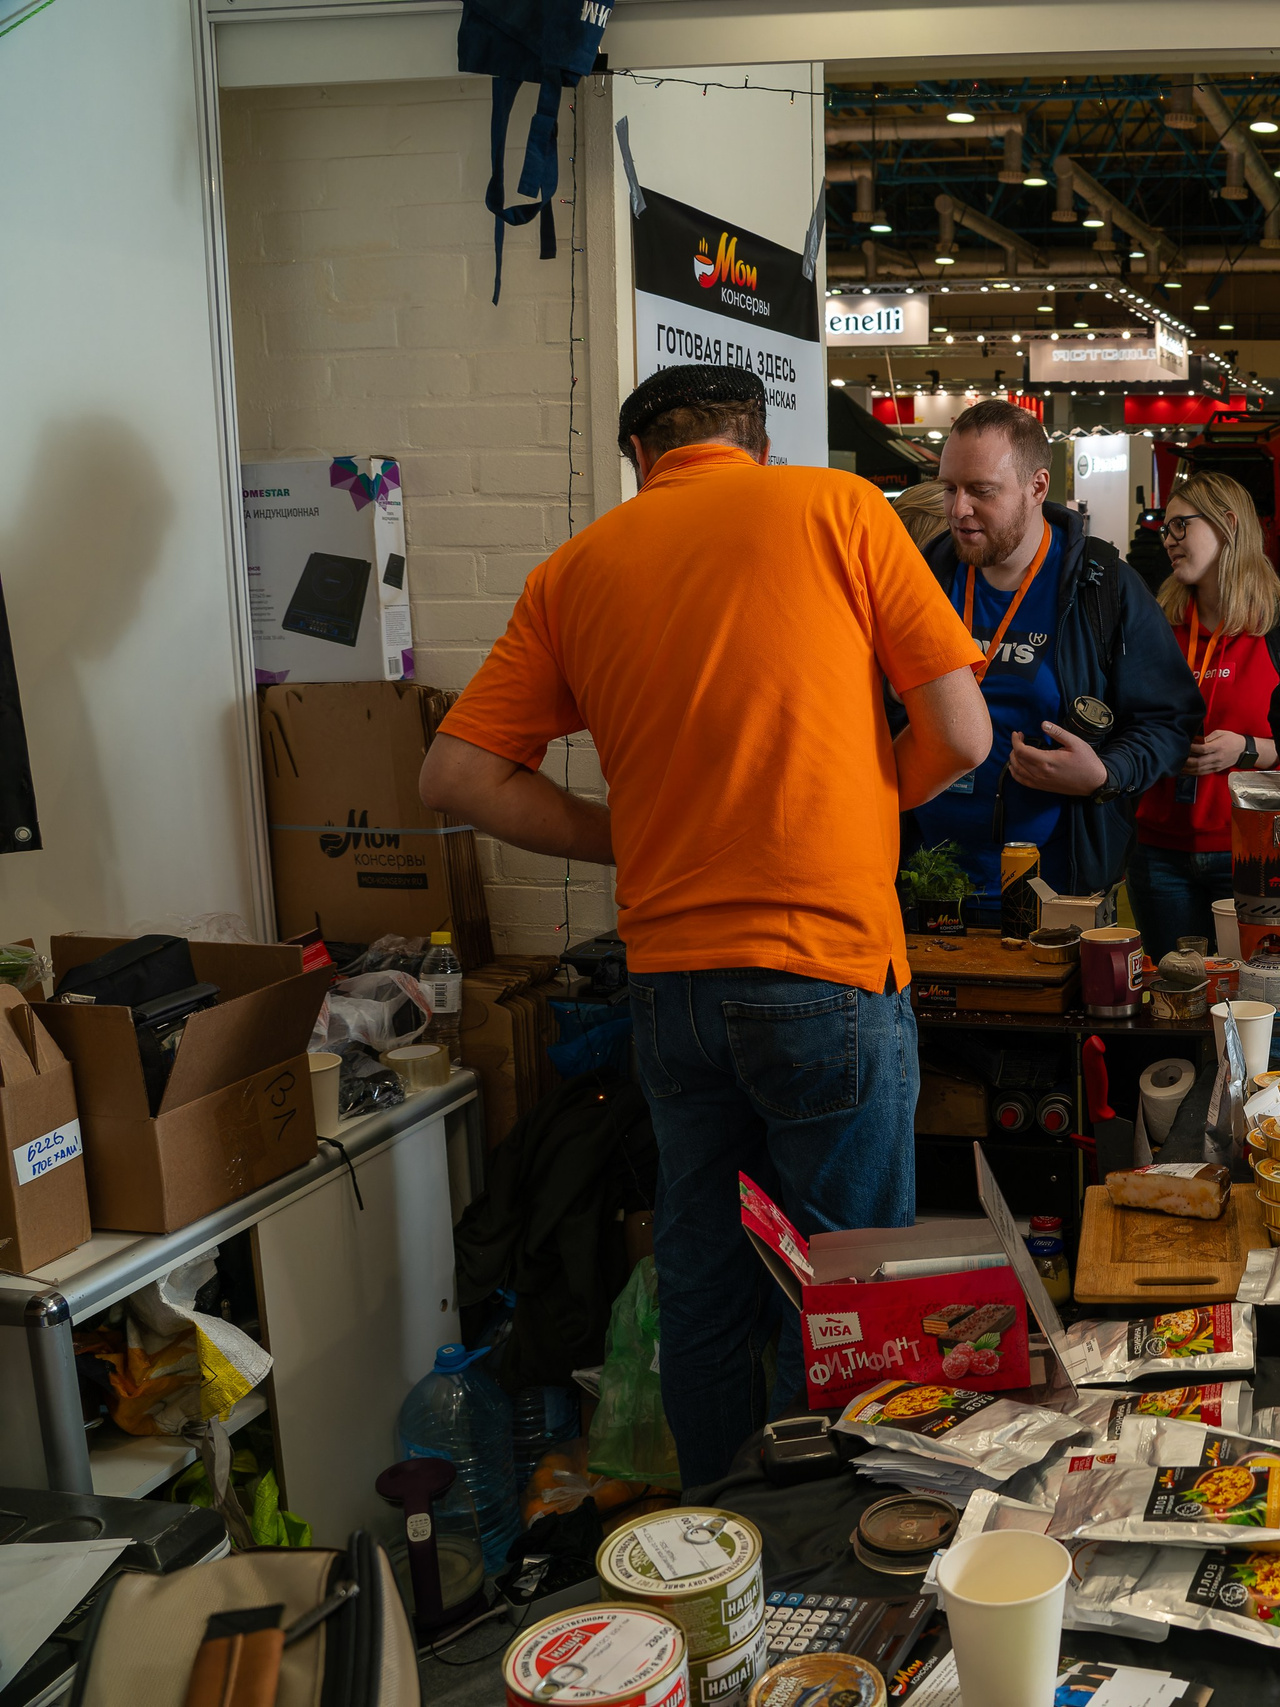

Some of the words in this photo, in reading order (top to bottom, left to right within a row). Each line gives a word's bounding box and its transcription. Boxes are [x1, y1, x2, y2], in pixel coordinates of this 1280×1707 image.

[710, 232, 758, 291] Мои
[721, 287, 770, 317] консервы
[829, 308, 902, 333] enelli
[657, 323, 722, 366] ГОТОВАЯ
[726, 342, 752, 372] ЕДА
[757, 351, 796, 383] ЗДЕСЬ
[764, 388, 797, 411] АНСКАЯ
[242, 488, 290, 498] OMESTAR
[253, 507, 320, 519] ИНДУКЦИОННАЯ
[354, 853, 426, 870] консервы
[28, 1132, 65, 1162] 6226
[818, 1325, 853, 1338] VISA
[807, 1335, 922, 1386] ФИНТИФАНТ
[1153, 1494, 1168, 1515] ПЛОВ
[1197, 1563, 1218, 1598] ПЛОВ
[727, 1577, 760, 1618] НАША!
[708, 1665, 751, 1697] НАША!
[894, 1658, 924, 1683] Мои
[911, 1656, 938, 1685] консервы
